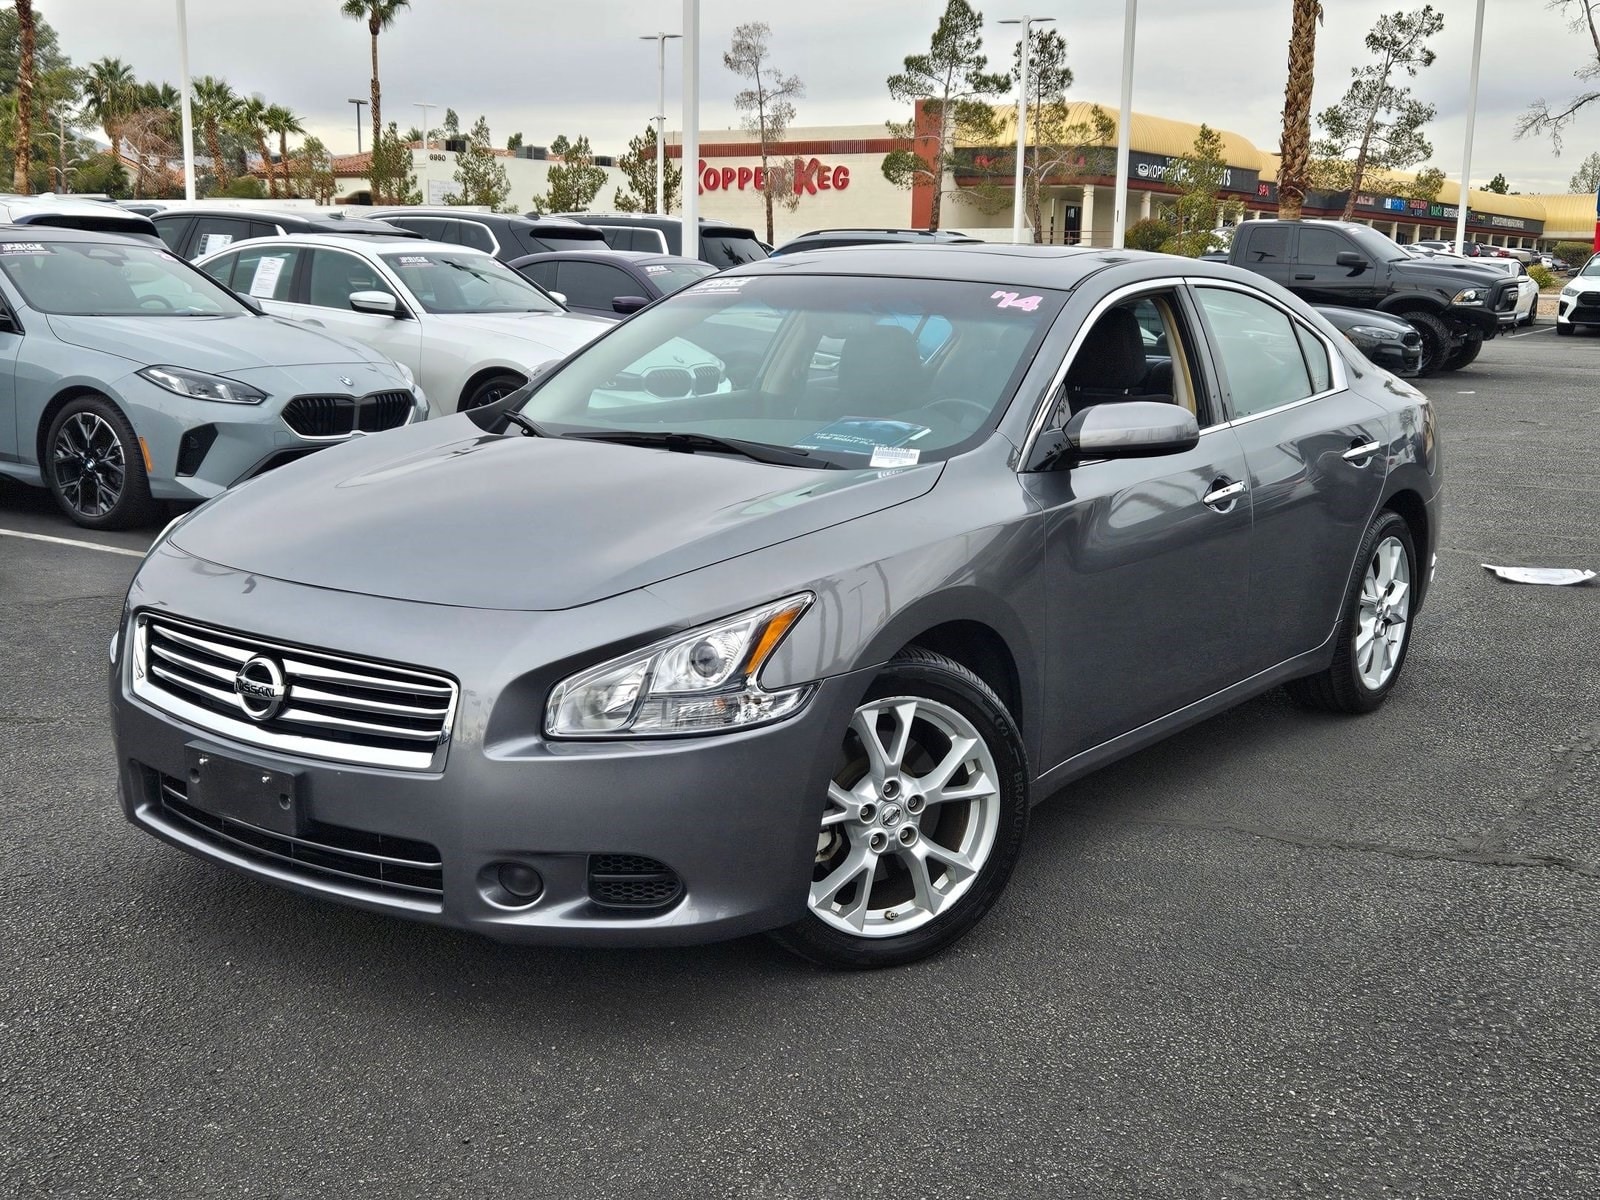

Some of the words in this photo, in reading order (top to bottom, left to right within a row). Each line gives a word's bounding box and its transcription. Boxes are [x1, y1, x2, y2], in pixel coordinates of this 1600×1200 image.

[793, 158, 850, 195] KEG
[1258, 184, 1269, 196] SPA
[235, 677, 275, 697] NISSAN
